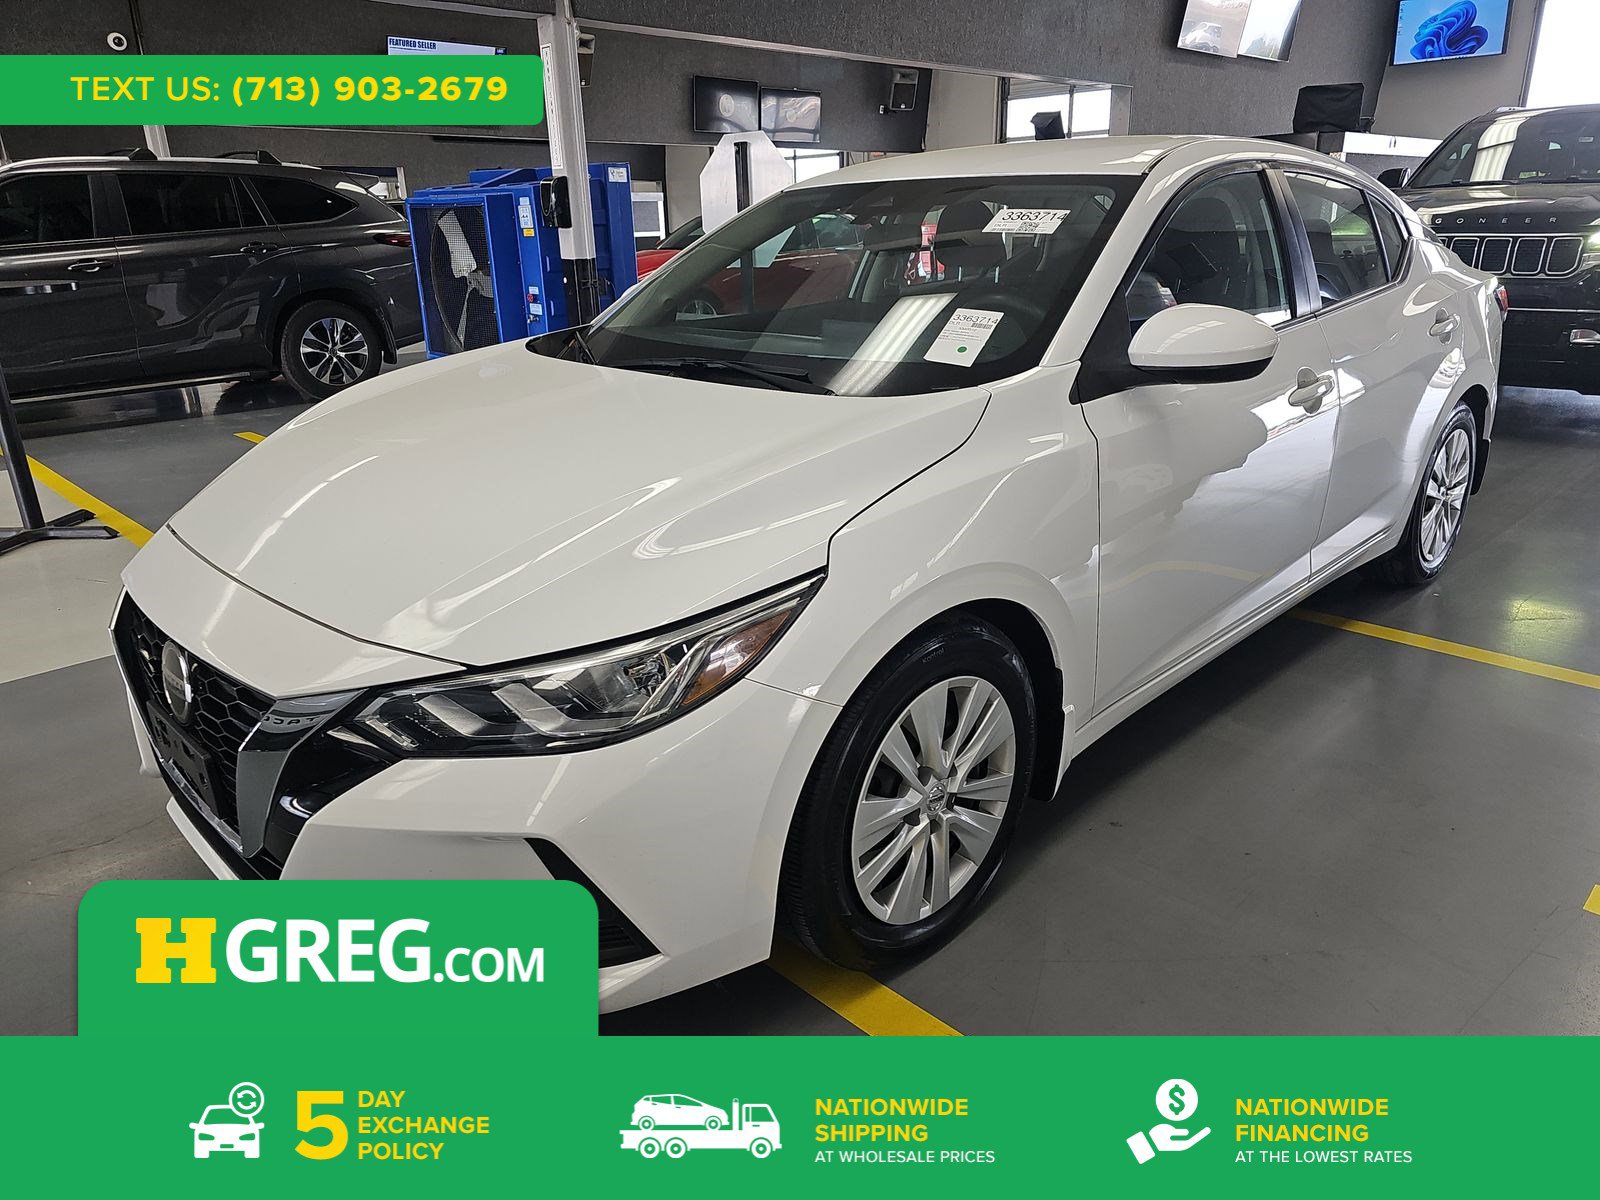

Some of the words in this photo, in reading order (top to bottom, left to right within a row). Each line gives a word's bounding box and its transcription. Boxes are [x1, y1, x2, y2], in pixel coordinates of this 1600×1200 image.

[388, 37, 417, 48] FEATURED
[417, 40, 437, 50] SELLER
[1001, 211, 1068, 222] 3363714
[952, 313, 999, 325] 3363714
